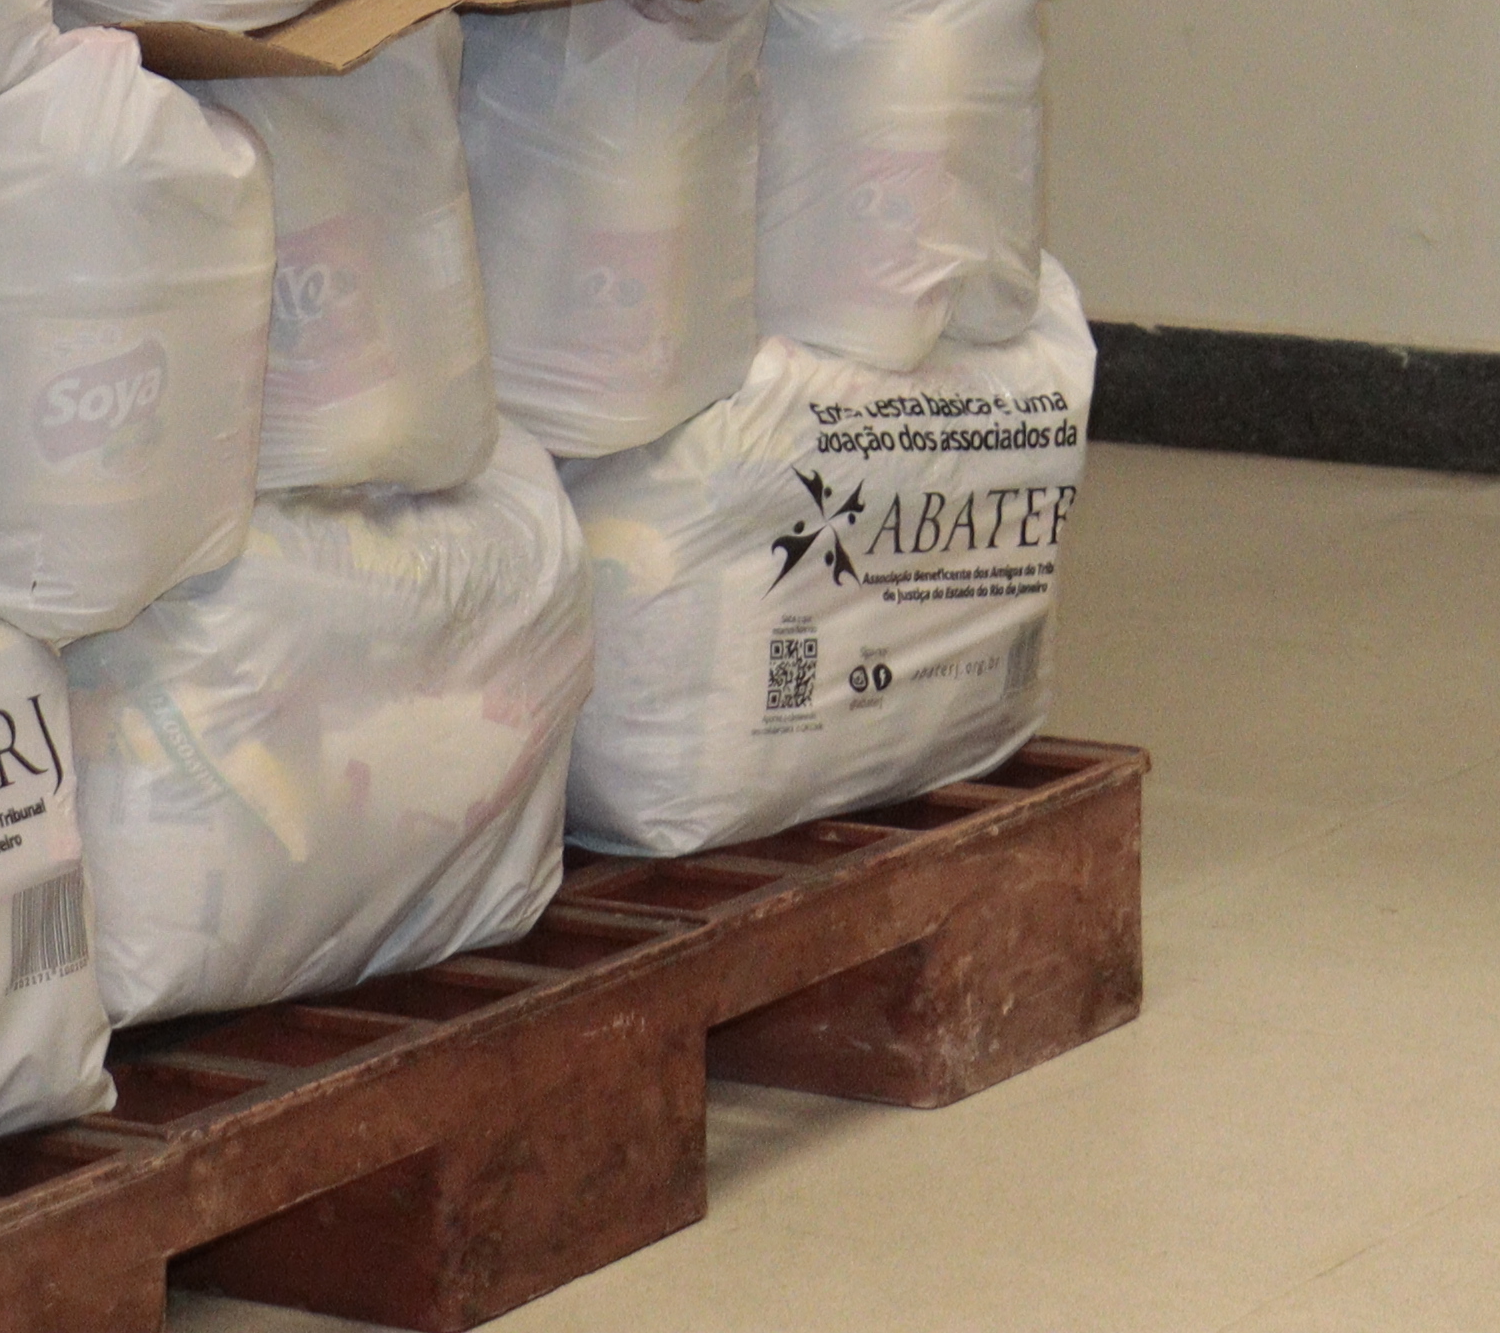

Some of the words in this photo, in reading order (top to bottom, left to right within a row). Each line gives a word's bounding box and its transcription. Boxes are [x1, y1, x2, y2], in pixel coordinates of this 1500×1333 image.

[41, 367, 162, 429] Soya
[1012, 392, 1068, 415] uma
[899, 424, 938, 452] dos
[940, 421, 1050, 451] associados
[1054, 418, 1078, 448] da
[973, 566, 990, 579] dos
[882, 589, 896, 601] de
[897, 587, 930, 604] Justiça
[932, 586, 944, 599] do
[945, 585, 975, 599] Estado
[976, 585, 988, 597] do
[989, 584, 1003, 597] Rio
[1005, 584, 1016, 596] de
[1015, 581, 1048, 597] Janeiro
